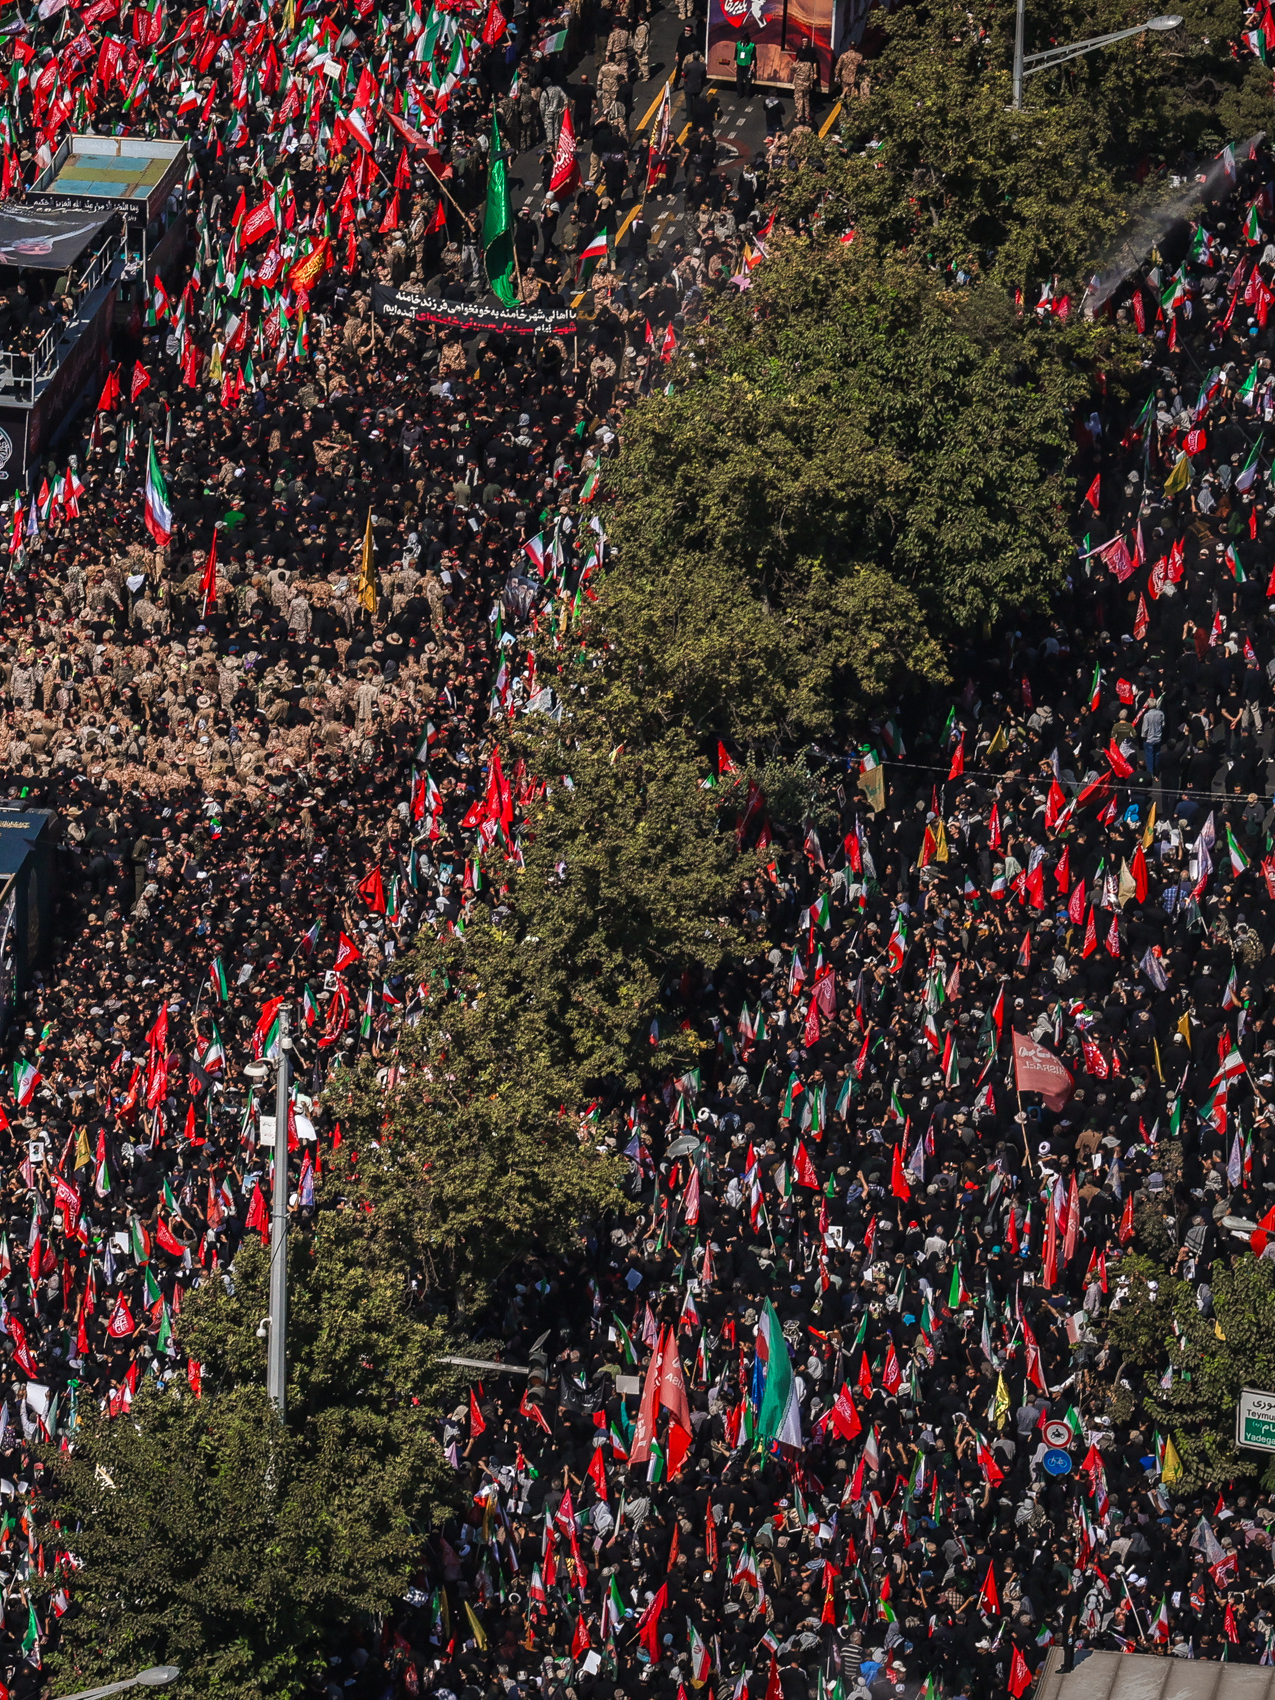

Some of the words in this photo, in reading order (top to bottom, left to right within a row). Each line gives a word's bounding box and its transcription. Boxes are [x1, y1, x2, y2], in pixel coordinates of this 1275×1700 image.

[395, 291, 421, 305] خامنه
[420, 296, 448, 312] فرزند
[447, 302, 491, 318] خونخواهی
[490, 308, 499, 319] به
[500, 308, 527, 320] خامنه
[525, 309, 546, 322] شهر
[545, 309, 568, 322] اهالی
[569, 309, 577, 320] ما
[1246, 1408, 1275, 1421] Teymu
[1246, 1432, 1275, 1446] Yadega
